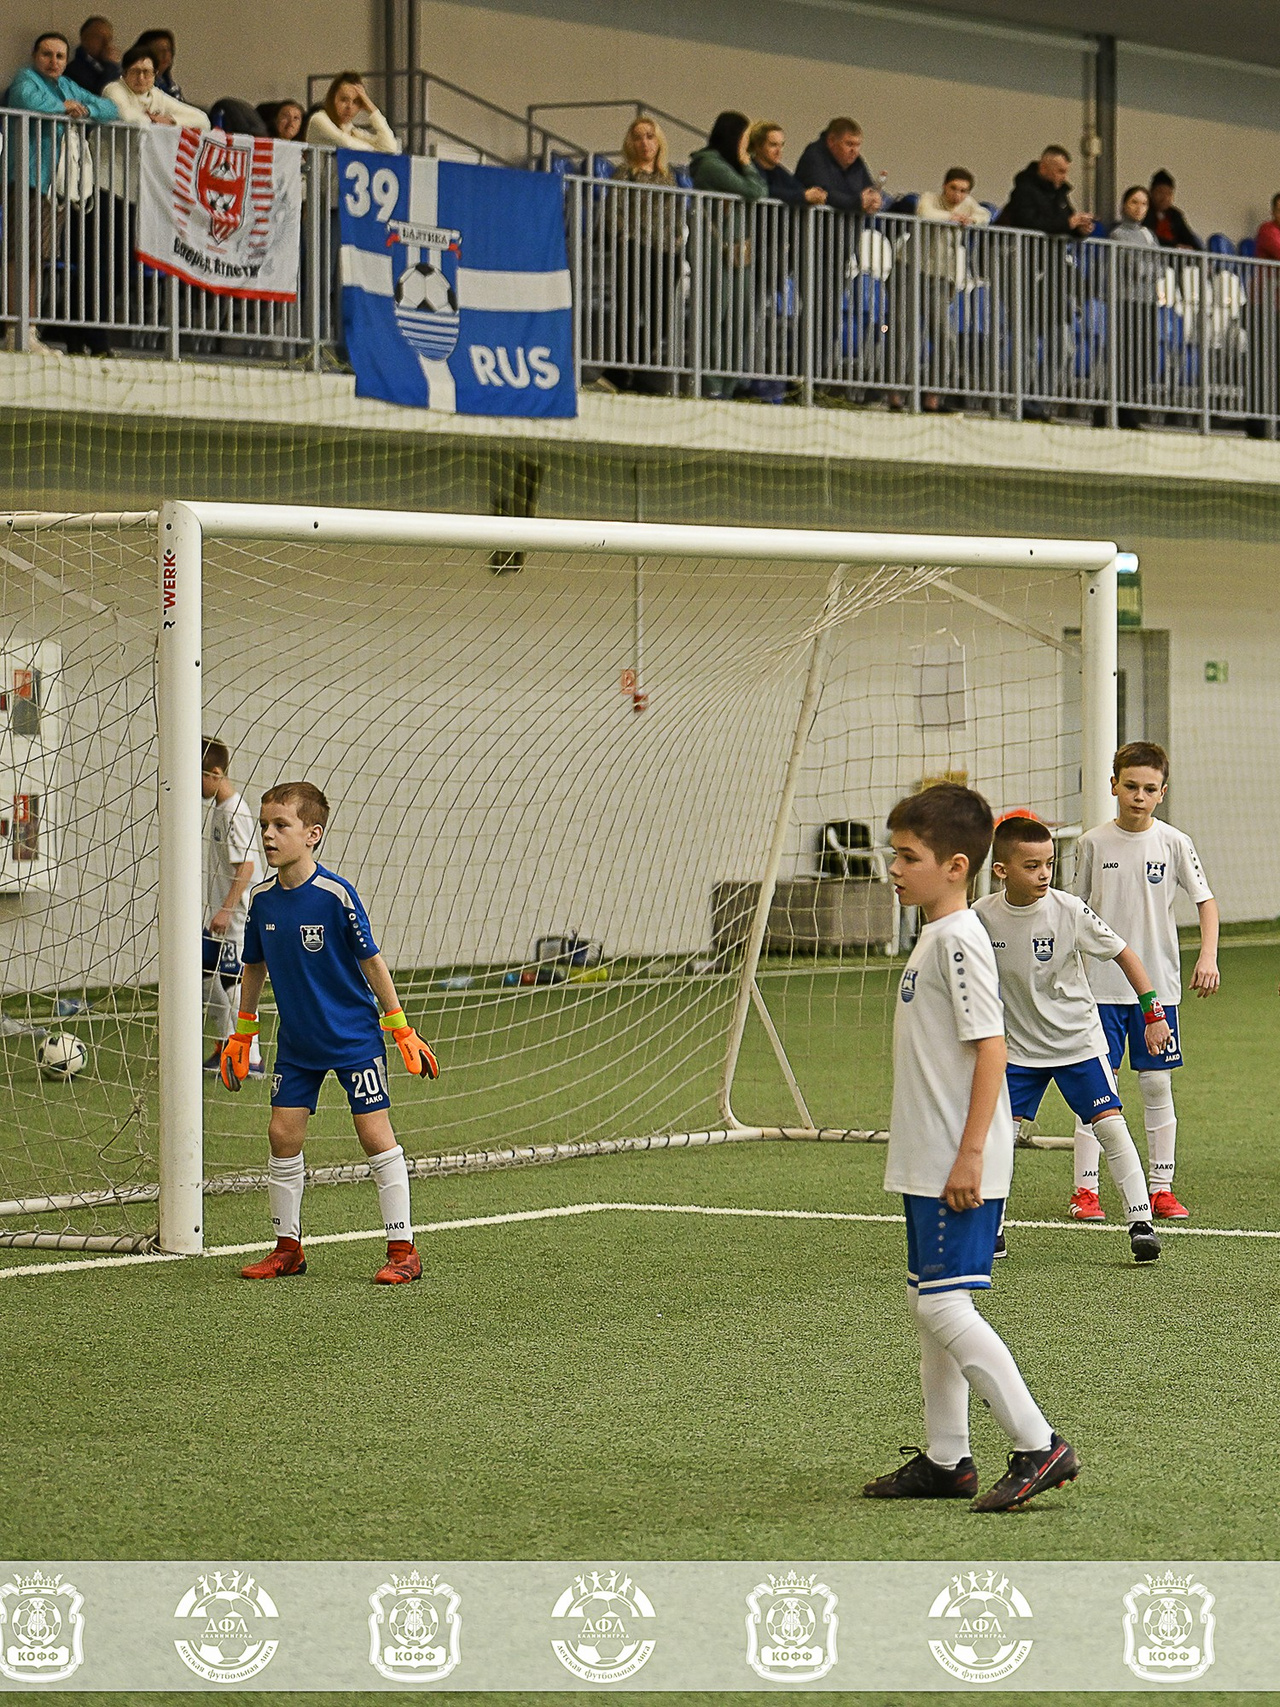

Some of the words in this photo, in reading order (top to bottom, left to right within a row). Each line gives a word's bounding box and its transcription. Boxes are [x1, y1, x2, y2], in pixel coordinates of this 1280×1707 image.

[344, 160, 400, 223] 39
[469, 344, 561, 390] RUS
[1102, 862, 1119, 870] JAKO
[1165, 1053, 1181, 1063] JAKO
[351, 1068, 380, 1099] 20
[365, 1094, 383, 1105] JAKO
[1093, 1095, 1111, 1108] JAKO
[1082, 1170, 1098, 1178] JAK
[1128, 1203, 1149, 1214] JAKO
[385, 1221, 405, 1231] JAKO
